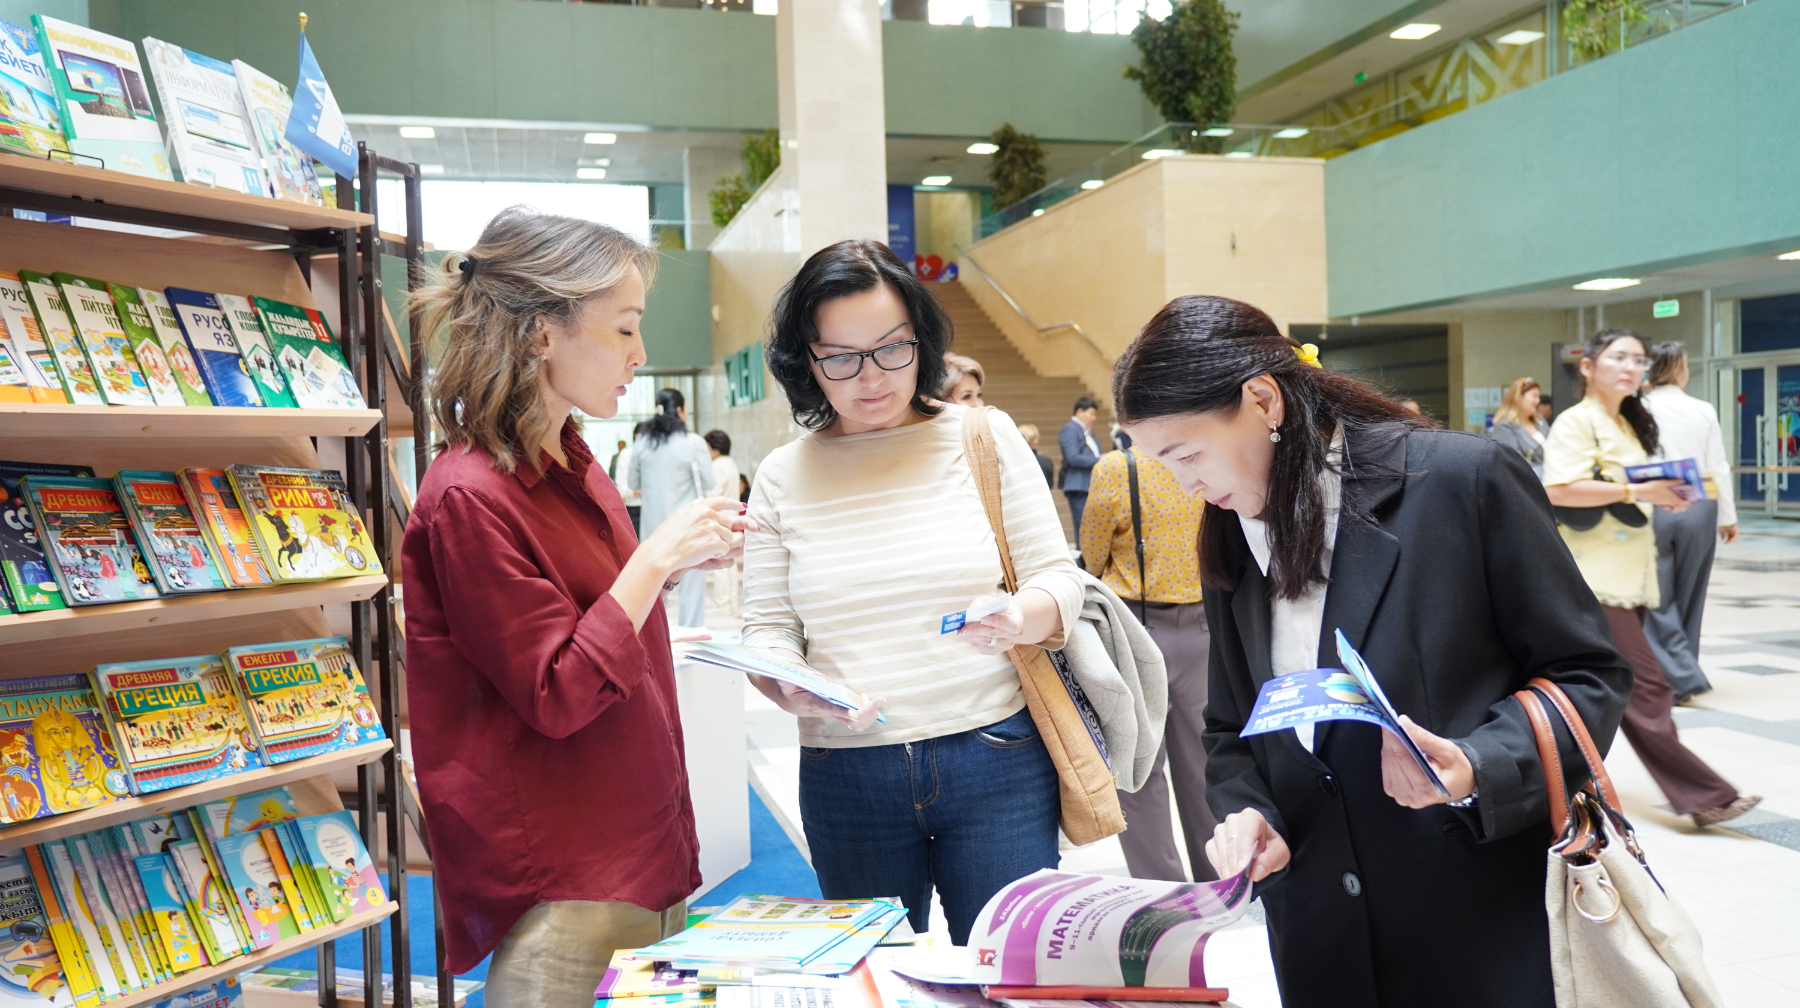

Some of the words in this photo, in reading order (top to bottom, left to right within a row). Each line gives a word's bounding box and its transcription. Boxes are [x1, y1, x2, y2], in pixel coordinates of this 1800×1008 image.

[46, 27, 136, 64] ИНФОРМАТИКА
[164, 70, 245, 106] ИНФОРМАТИКА
[153, 153, 167, 174] 5
[245, 170, 261, 189] 11
[312, 321, 328, 339] 11
[265, 475, 307, 486] ДРЕВНИЙ
[46, 490, 119, 508] ДРЕВНИЙ
[270, 488, 313, 508] РИМ
[243, 655, 287, 667] ЕЖЕЛГІ
[116, 670, 173, 688] ДРЕВНЯЯ
[249, 664, 317, 688] ГРЕКИЯ
[119, 684, 201, 708] ГРЕЦИЯ
[360, 710, 369, 721] 8
[113, 774, 125, 789] 8
[1046, 884, 1136, 960] МАТЕМАТИКА
